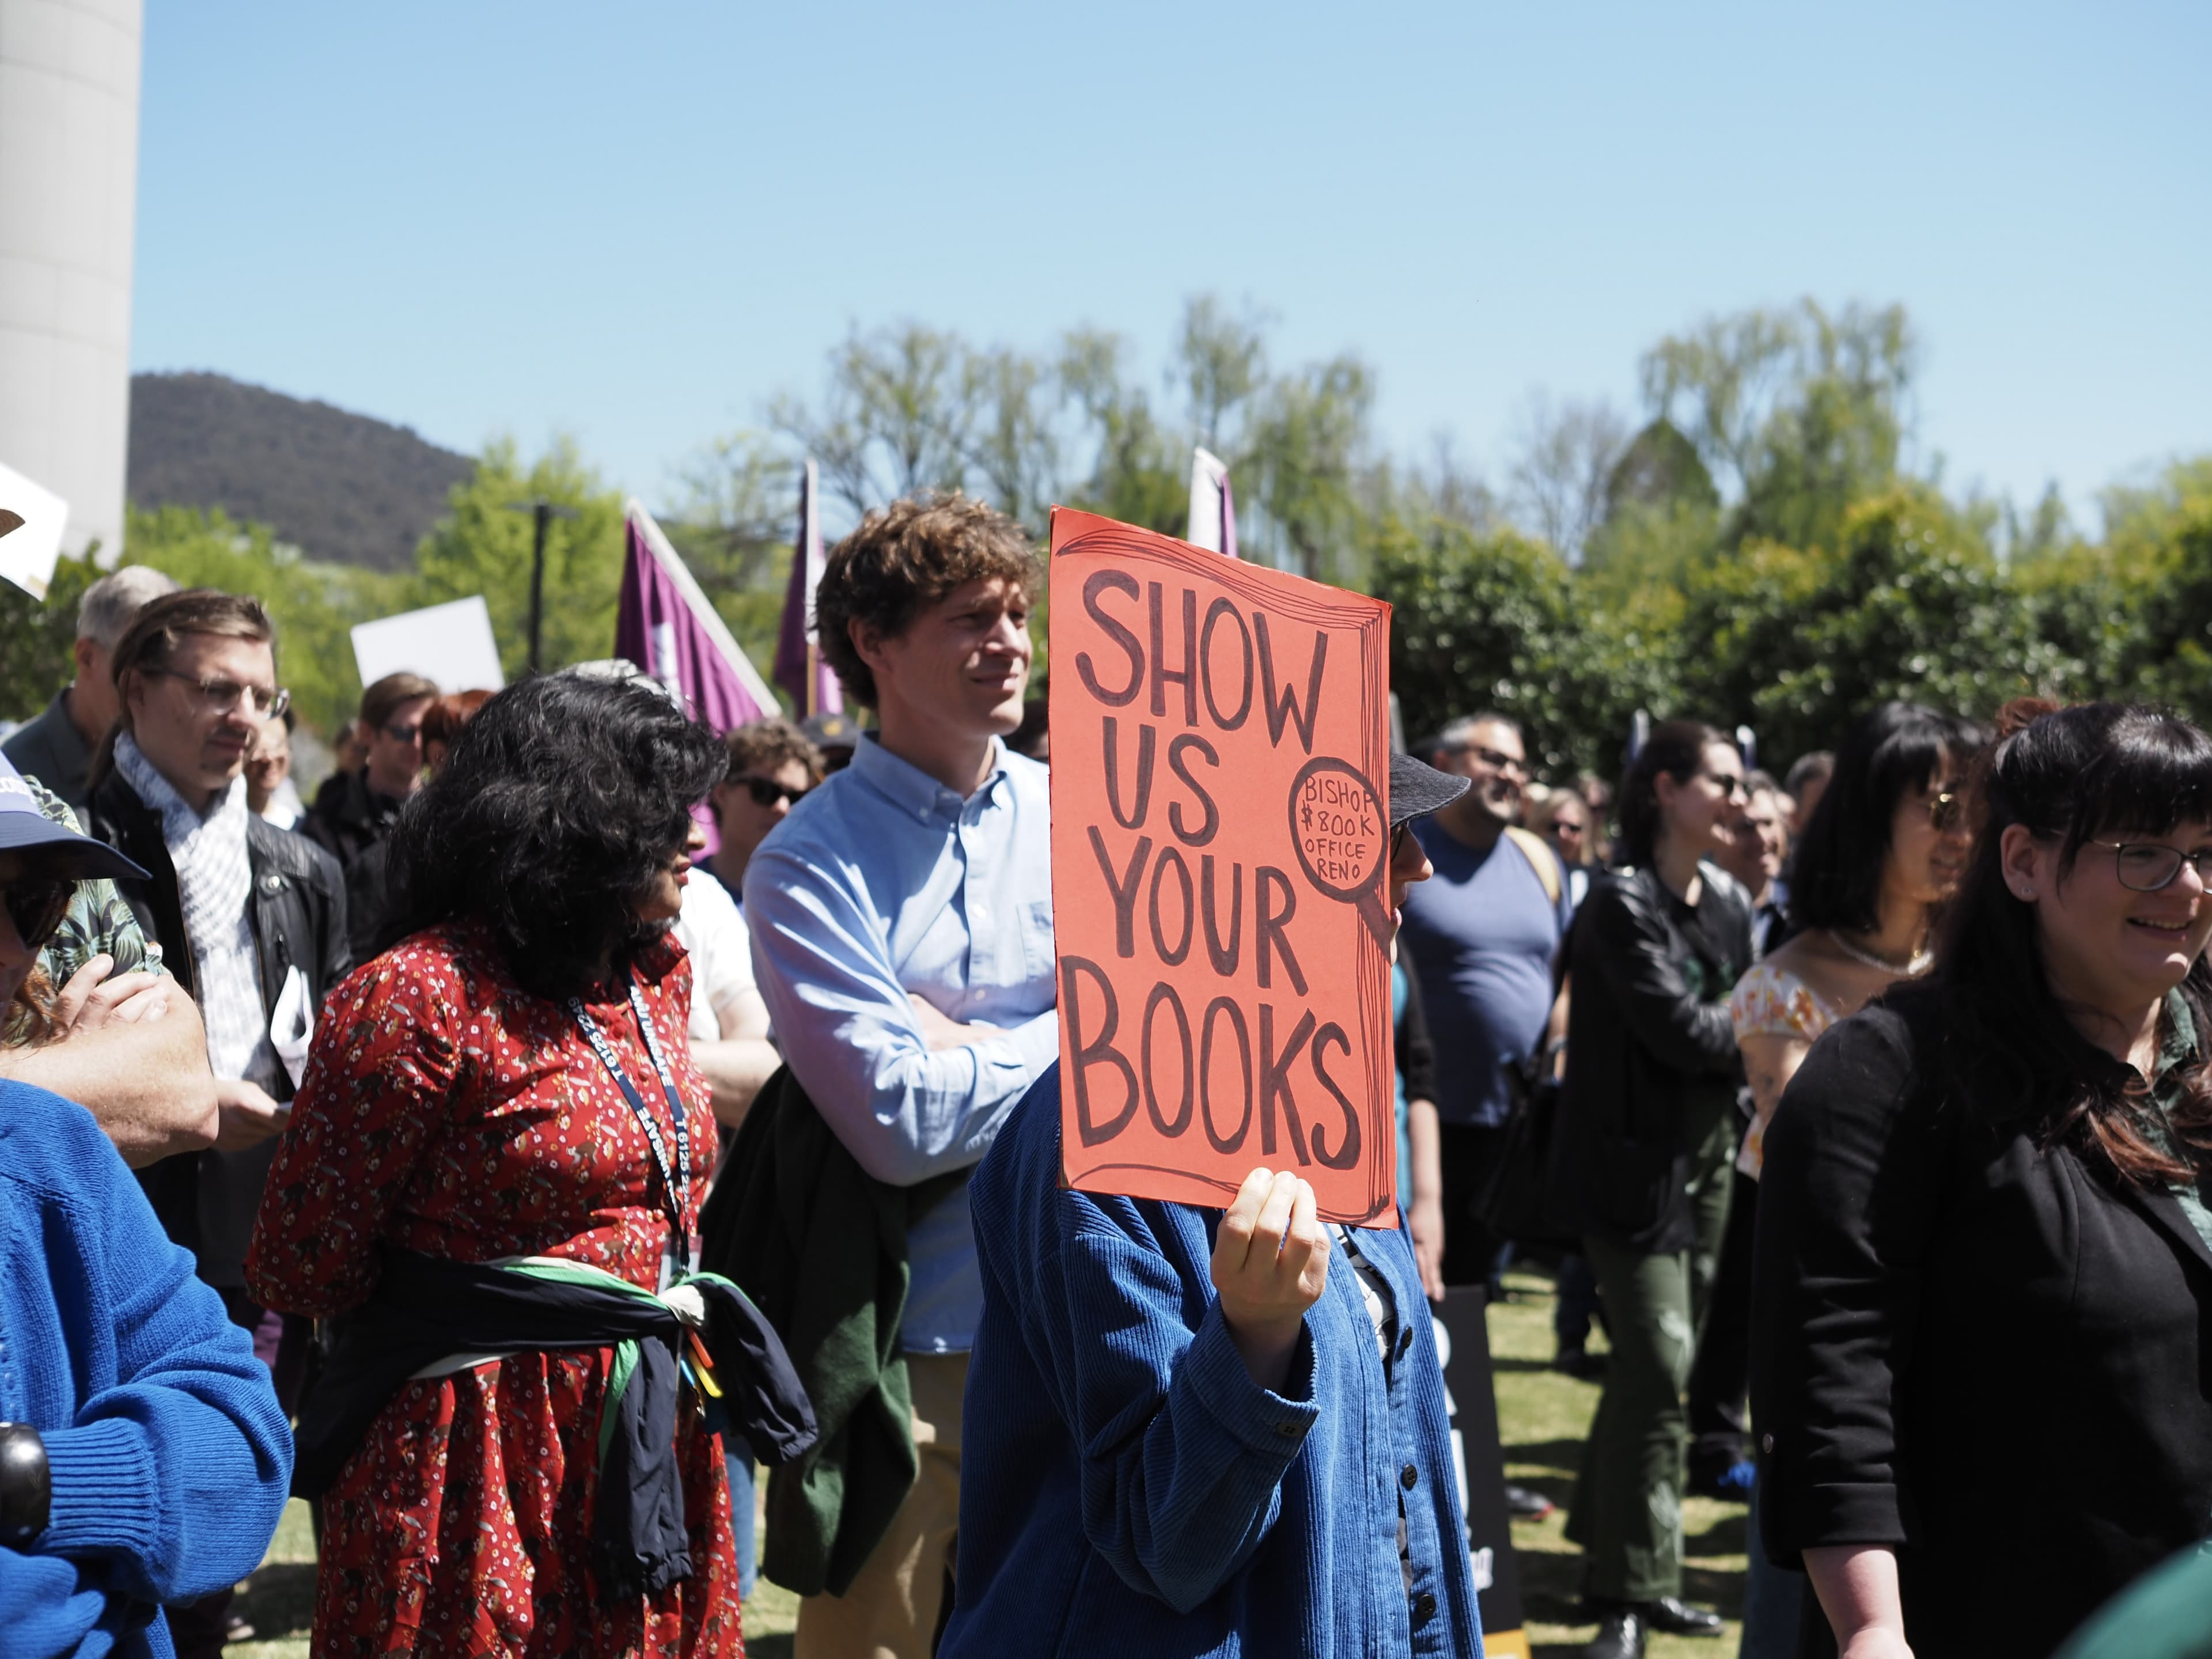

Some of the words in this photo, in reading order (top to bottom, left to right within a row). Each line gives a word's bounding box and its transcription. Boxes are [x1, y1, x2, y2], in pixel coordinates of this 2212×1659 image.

[1075, 569, 1328, 755] SHOW
[1102, 716, 1219, 847] US
[1305, 776, 1374, 813] BISHOP
[1301, 800, 1375, 836] $800K
[1305, 838, 1366, 859] OFFICE
[1317, 858, 1361, 881] RENO
[1086, 825, 1309, 997] YOUR
[567, 996, 596, 1032] 2249
[589, 1031, 617, 1068] 6125
[641, 1020, 675, 1087] UNISAFE
[1059, 955, 1362, 1171] BOOKS
[611, 1069, 623, 1082] T
[675, 1118, 688, 1130] T
[637, 1107, 671, 1179] UNISAFE
[677, 1131, 691, 1172] 6125
